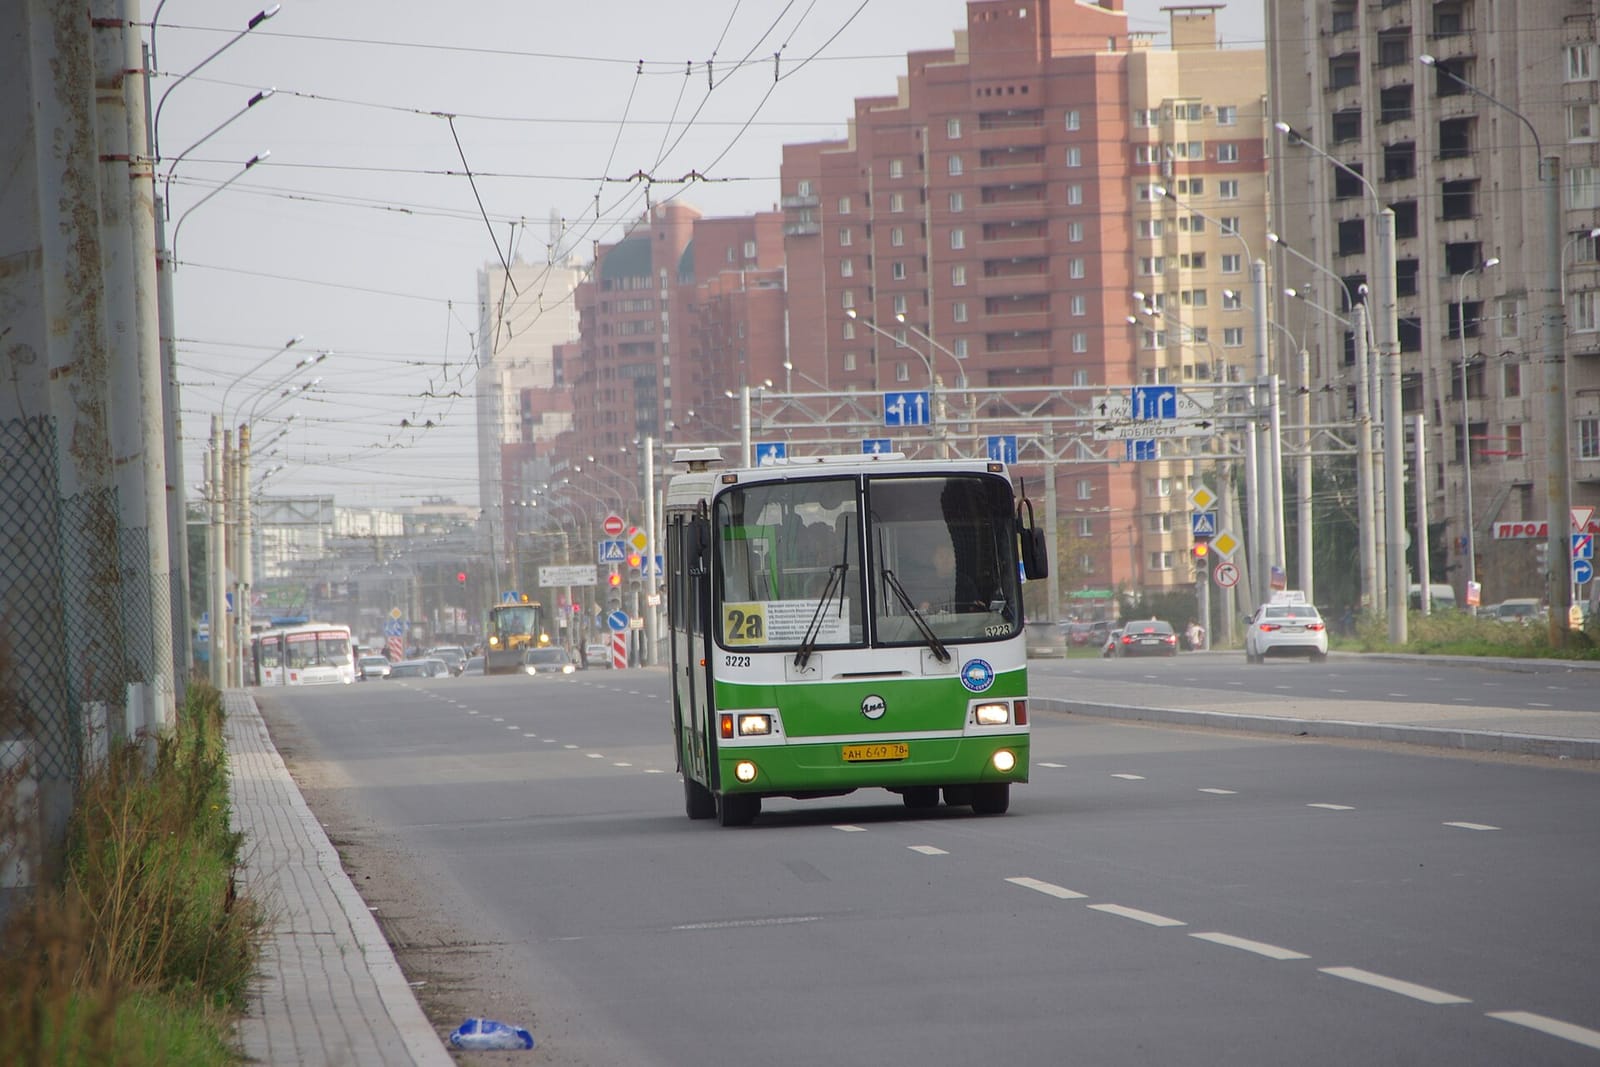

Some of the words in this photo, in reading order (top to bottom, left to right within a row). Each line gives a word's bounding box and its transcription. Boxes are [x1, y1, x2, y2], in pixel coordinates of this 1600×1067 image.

[727, 609, 763, 640] 2а
[985, 625, 1010, 637] 3223
[725, 656, 751, 667] 3223
[848, 750, 861, 759] АН
[866, 746, 887, 758] 649
[893, 745, 904, 754] 78
